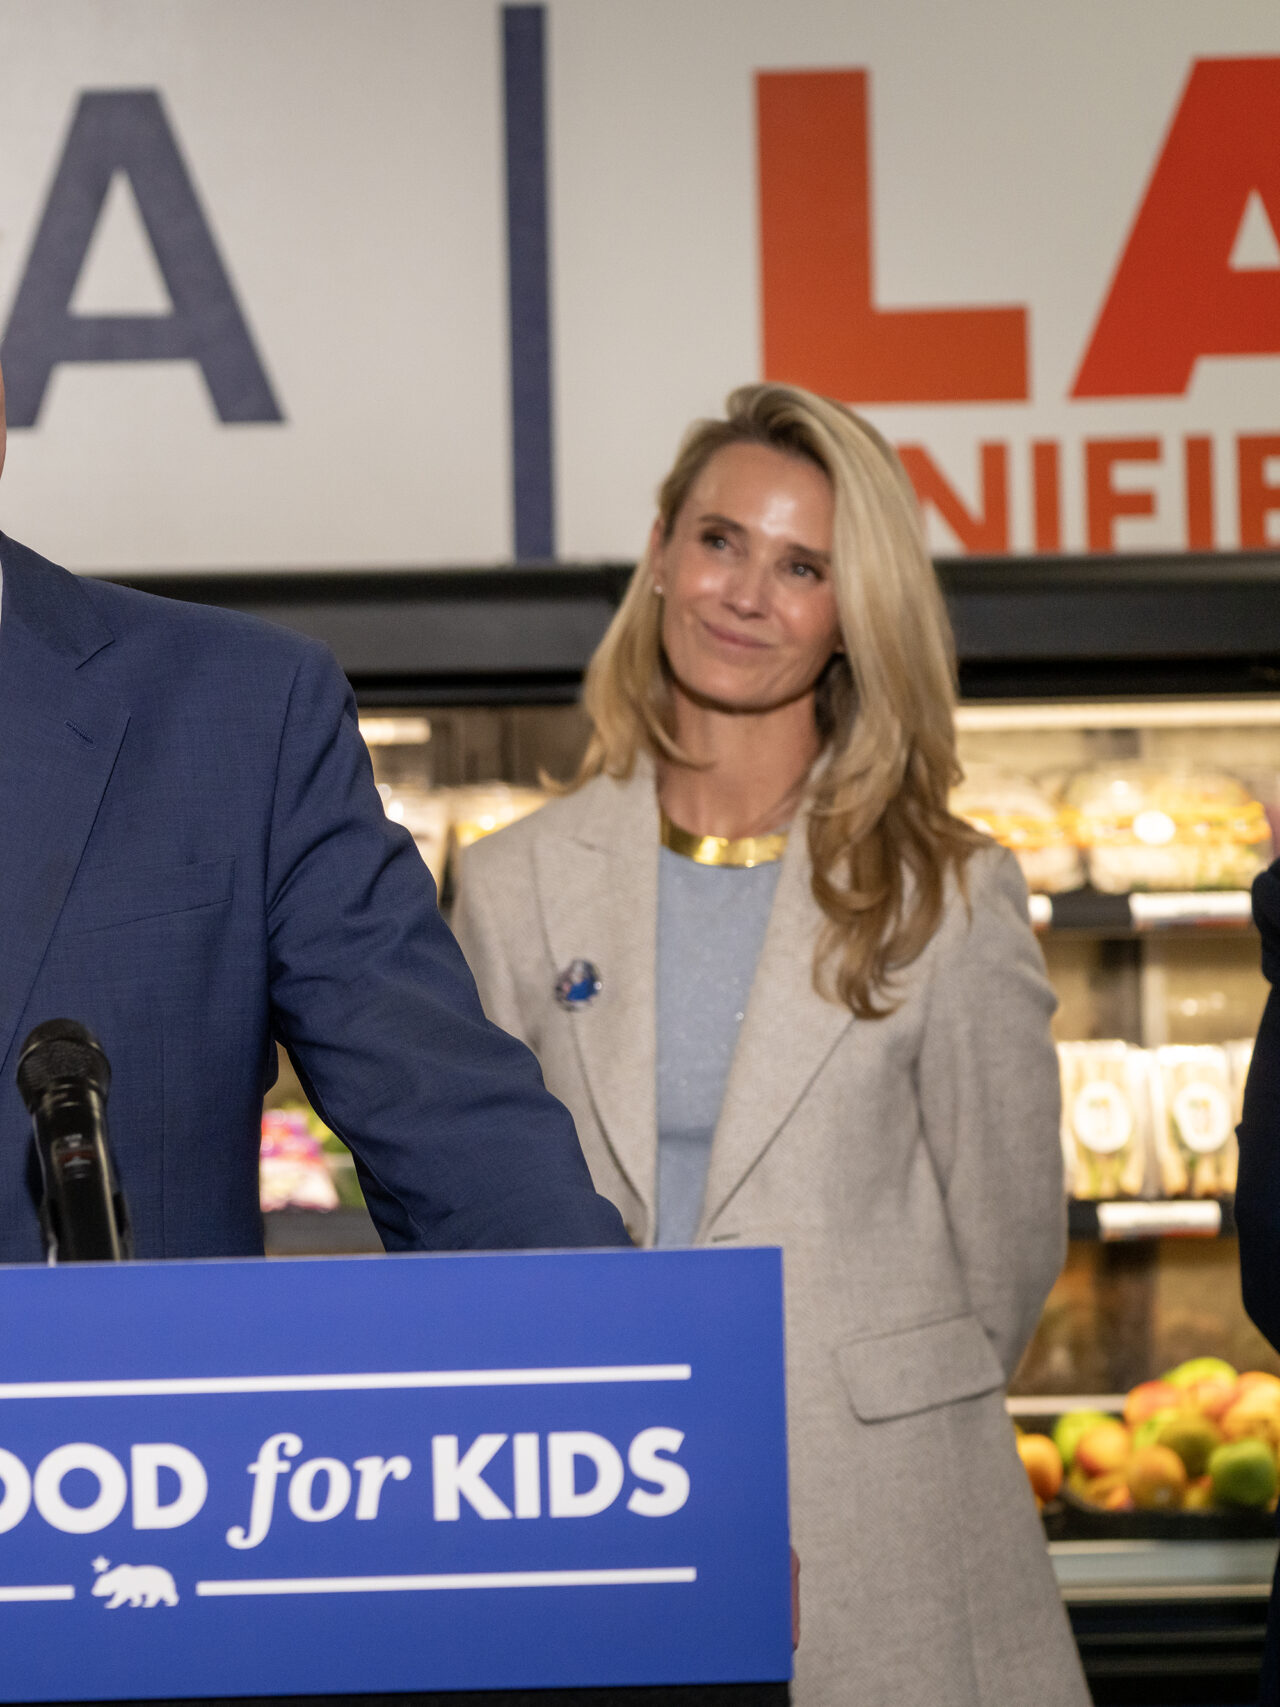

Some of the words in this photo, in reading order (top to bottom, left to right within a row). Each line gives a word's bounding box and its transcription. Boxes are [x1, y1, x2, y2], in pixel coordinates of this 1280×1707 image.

[754, 55, 1280, 404] LA
[225, 1431, 412, 1551] for
[430, 1425, 692, 1523] KIDS
